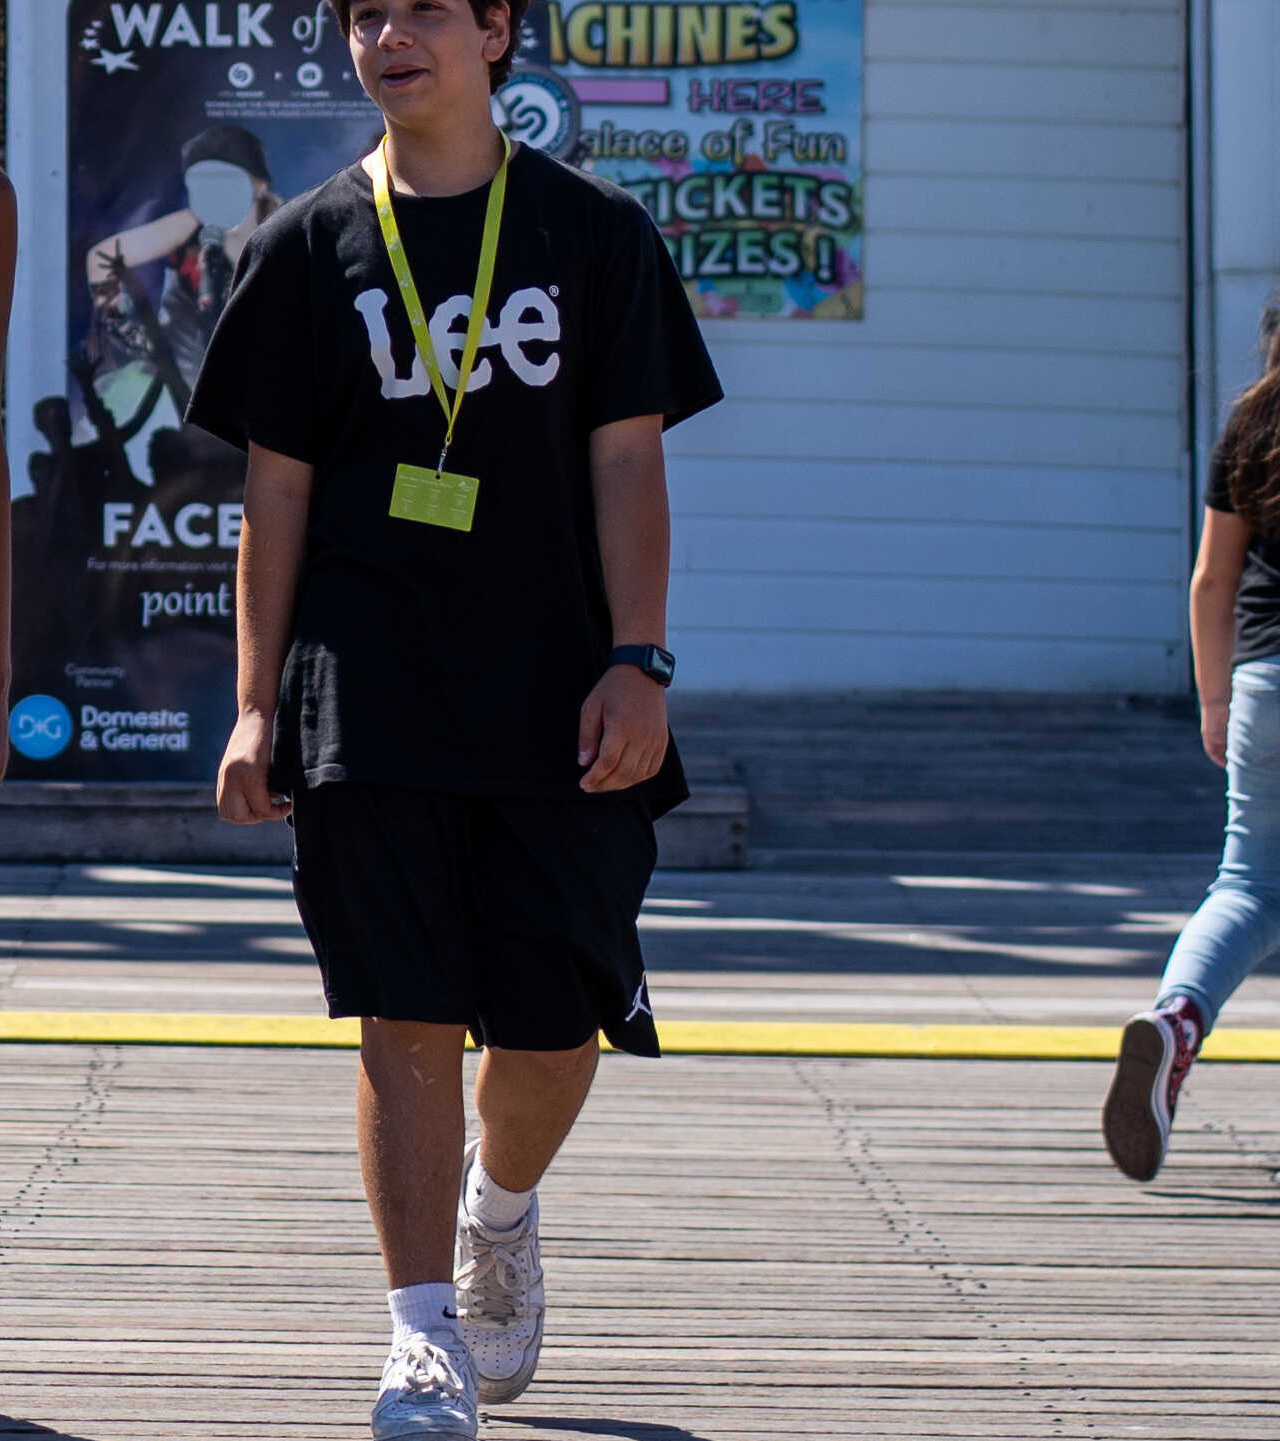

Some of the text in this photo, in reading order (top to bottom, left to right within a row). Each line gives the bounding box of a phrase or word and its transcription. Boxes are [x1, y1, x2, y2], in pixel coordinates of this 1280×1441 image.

[110, 0, 334, 54] WALK of
[690, 79, 826, 114] HERE
[578, 118, 848, 165] alace of Fun
[353, 286, 562, 401] Lee
[102, 502, 245, 549] FACE
[140, 582, 232, 628] point
[80, 705, 190, 728] Domestic
[80, 728, 191, 752] & General
